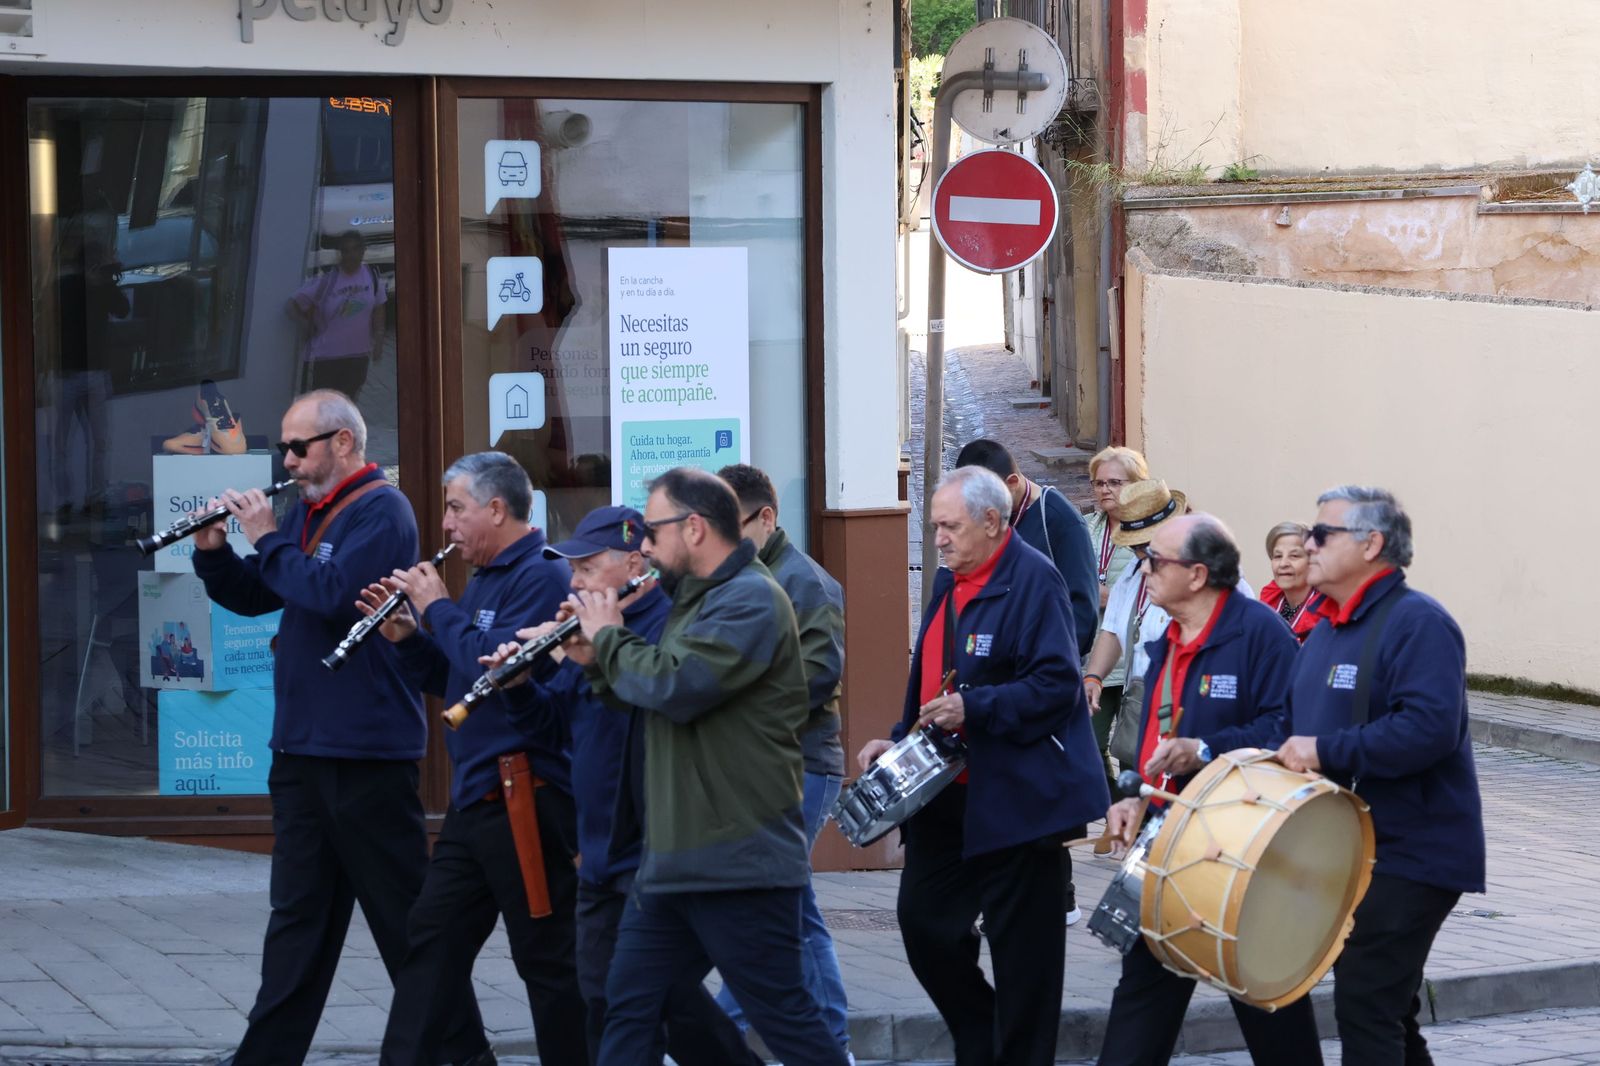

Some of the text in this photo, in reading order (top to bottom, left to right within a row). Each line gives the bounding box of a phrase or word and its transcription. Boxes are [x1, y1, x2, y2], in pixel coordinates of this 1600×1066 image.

[620, 276, 664, 285] En la cancha
[620, 290, 625, 301] y
[637, 289, 645, 297] tu
[620, 313, 689, 333] Necesitas
[531, 346, 600, 361] Personas
[620, 341, 692, 360] un seguro
[620, 360, 709, 384] que siempre
[621, 382, 717, 407] te acompañe.
[630, 434, 693, 447] Cuida tu hogar.
[630, 446, 711, 461] Ahora, con garantía
[630, 462, 641, 474] de
[224, 625, 263, 635] Tenemos
[224, 638, 271, 650] seguro par
[224, 650, 246, 662] cada
[248, 651, 265, 660] una
[225, 666, 240, 675] tus
[174, 730, 243, 749] Solicita
[175, 751, 254, 770] más info
[175, 773, 221, 796] aquí.
